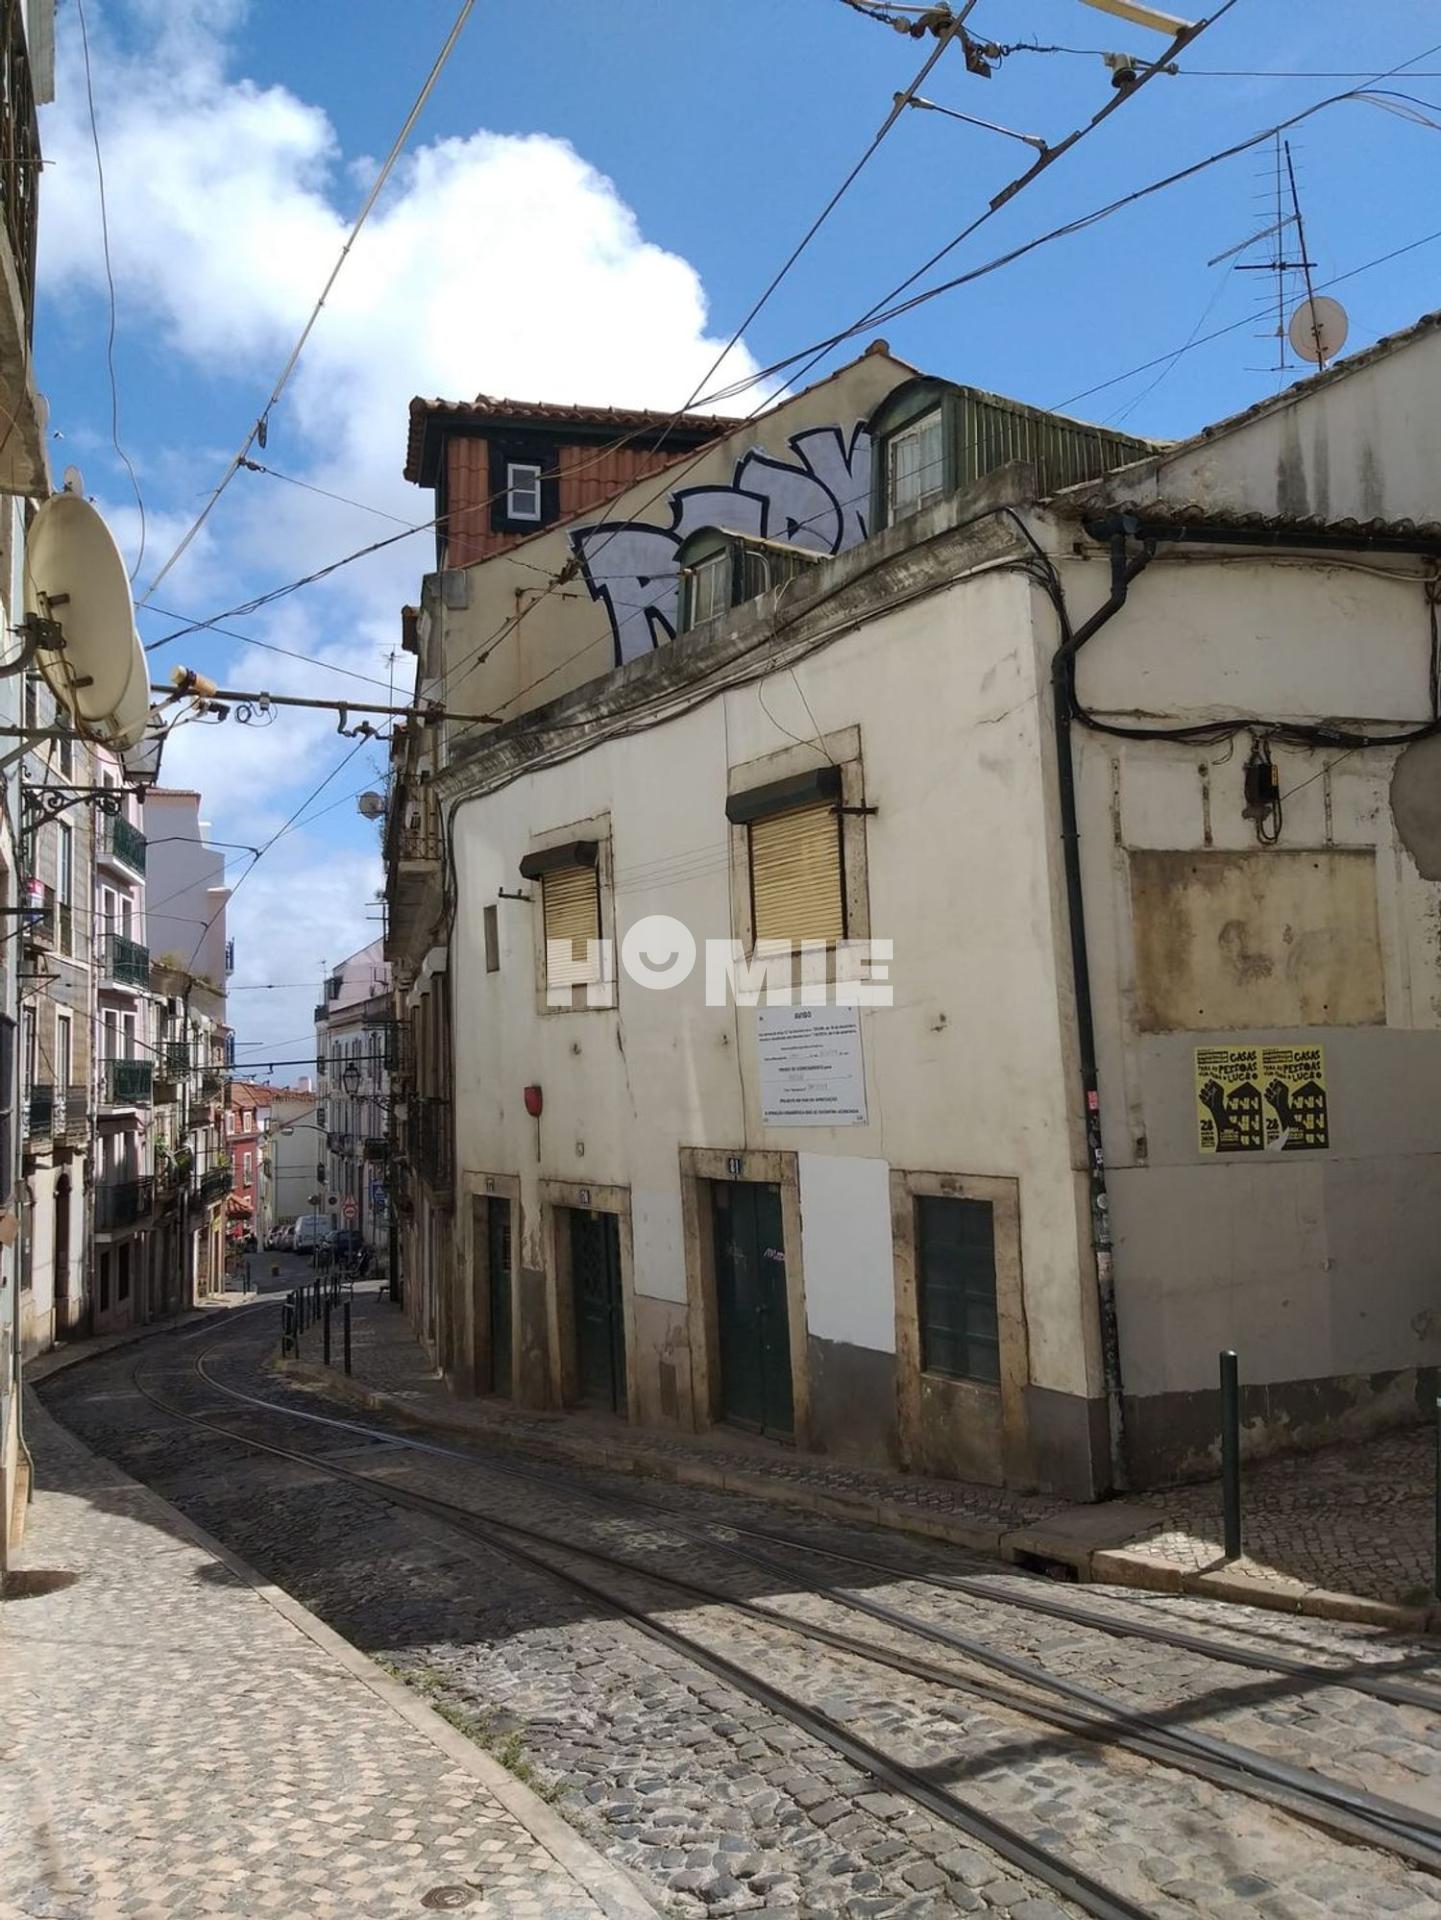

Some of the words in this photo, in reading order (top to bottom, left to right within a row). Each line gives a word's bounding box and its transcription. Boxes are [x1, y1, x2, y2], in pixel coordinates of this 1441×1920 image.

[1230, 1051, 1257, 1062] CASAS
[1294, 1050, 1320, 1062] CASAS
[1228, 1072, 1258, 1083] LUCRO
[1293, 1072, 1322, 1082] LUCRO
